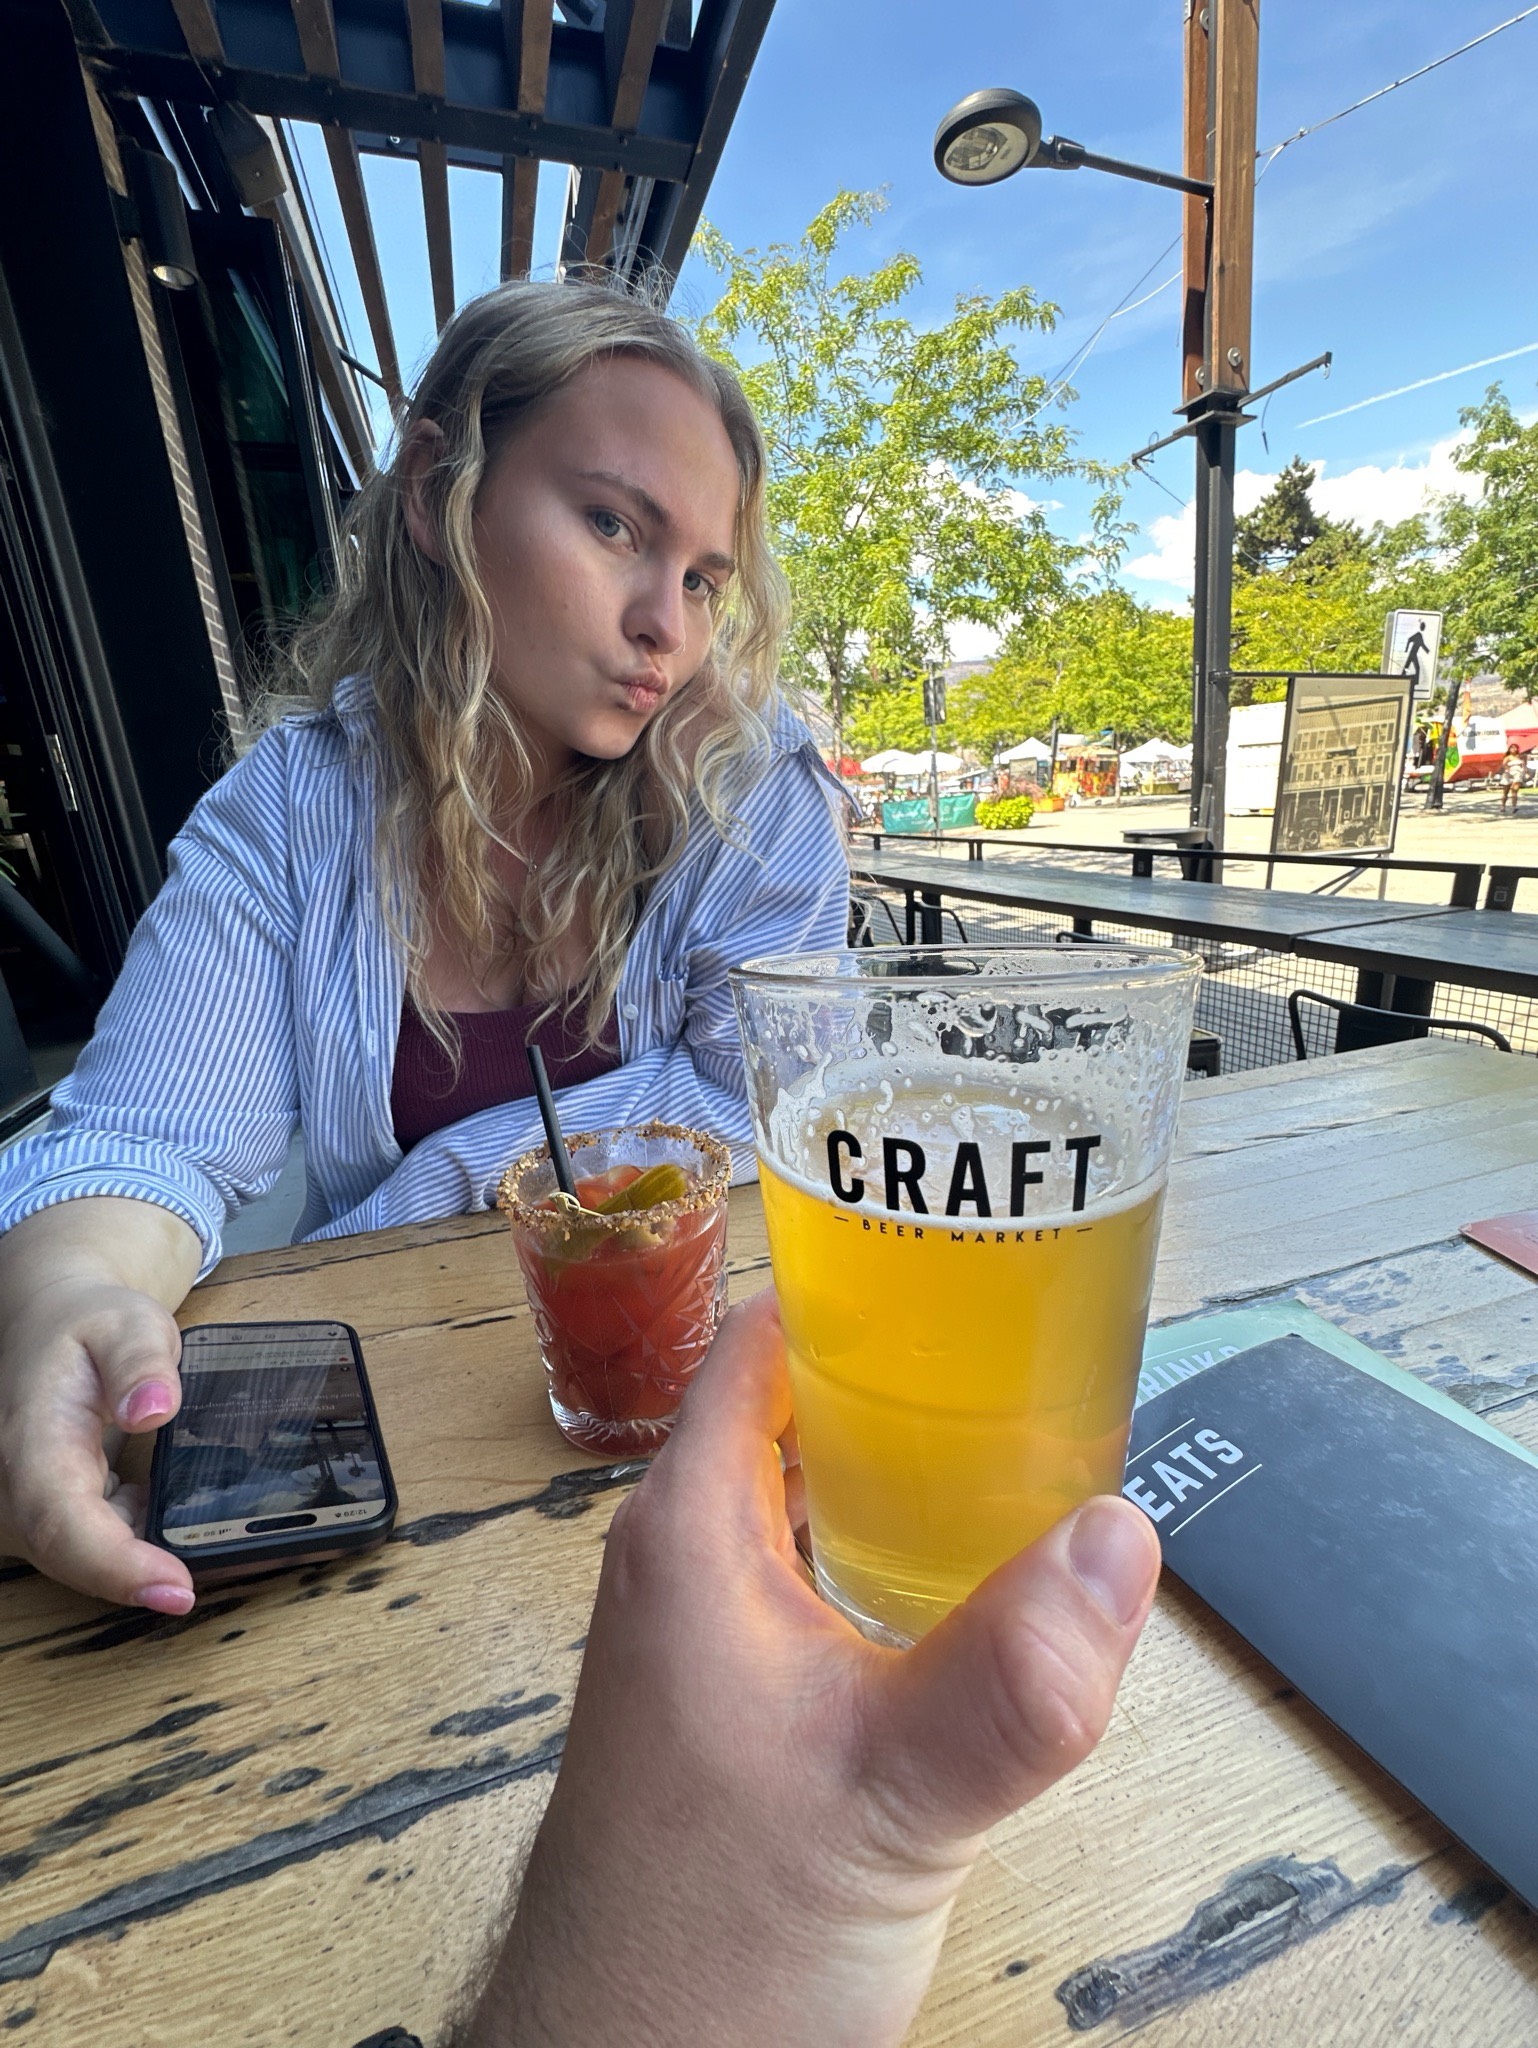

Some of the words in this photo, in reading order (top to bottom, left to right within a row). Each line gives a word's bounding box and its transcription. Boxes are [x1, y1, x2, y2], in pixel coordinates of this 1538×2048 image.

[827, 1130, 1102, 1217] CRAFT
[862, 1218, 925, 1239] BEER
[951, 1227, 1062, 1243] MARKET
[1135, 1345, 1241, 1408] RINK
[1122, 1428, 1244, 1523] EATS
